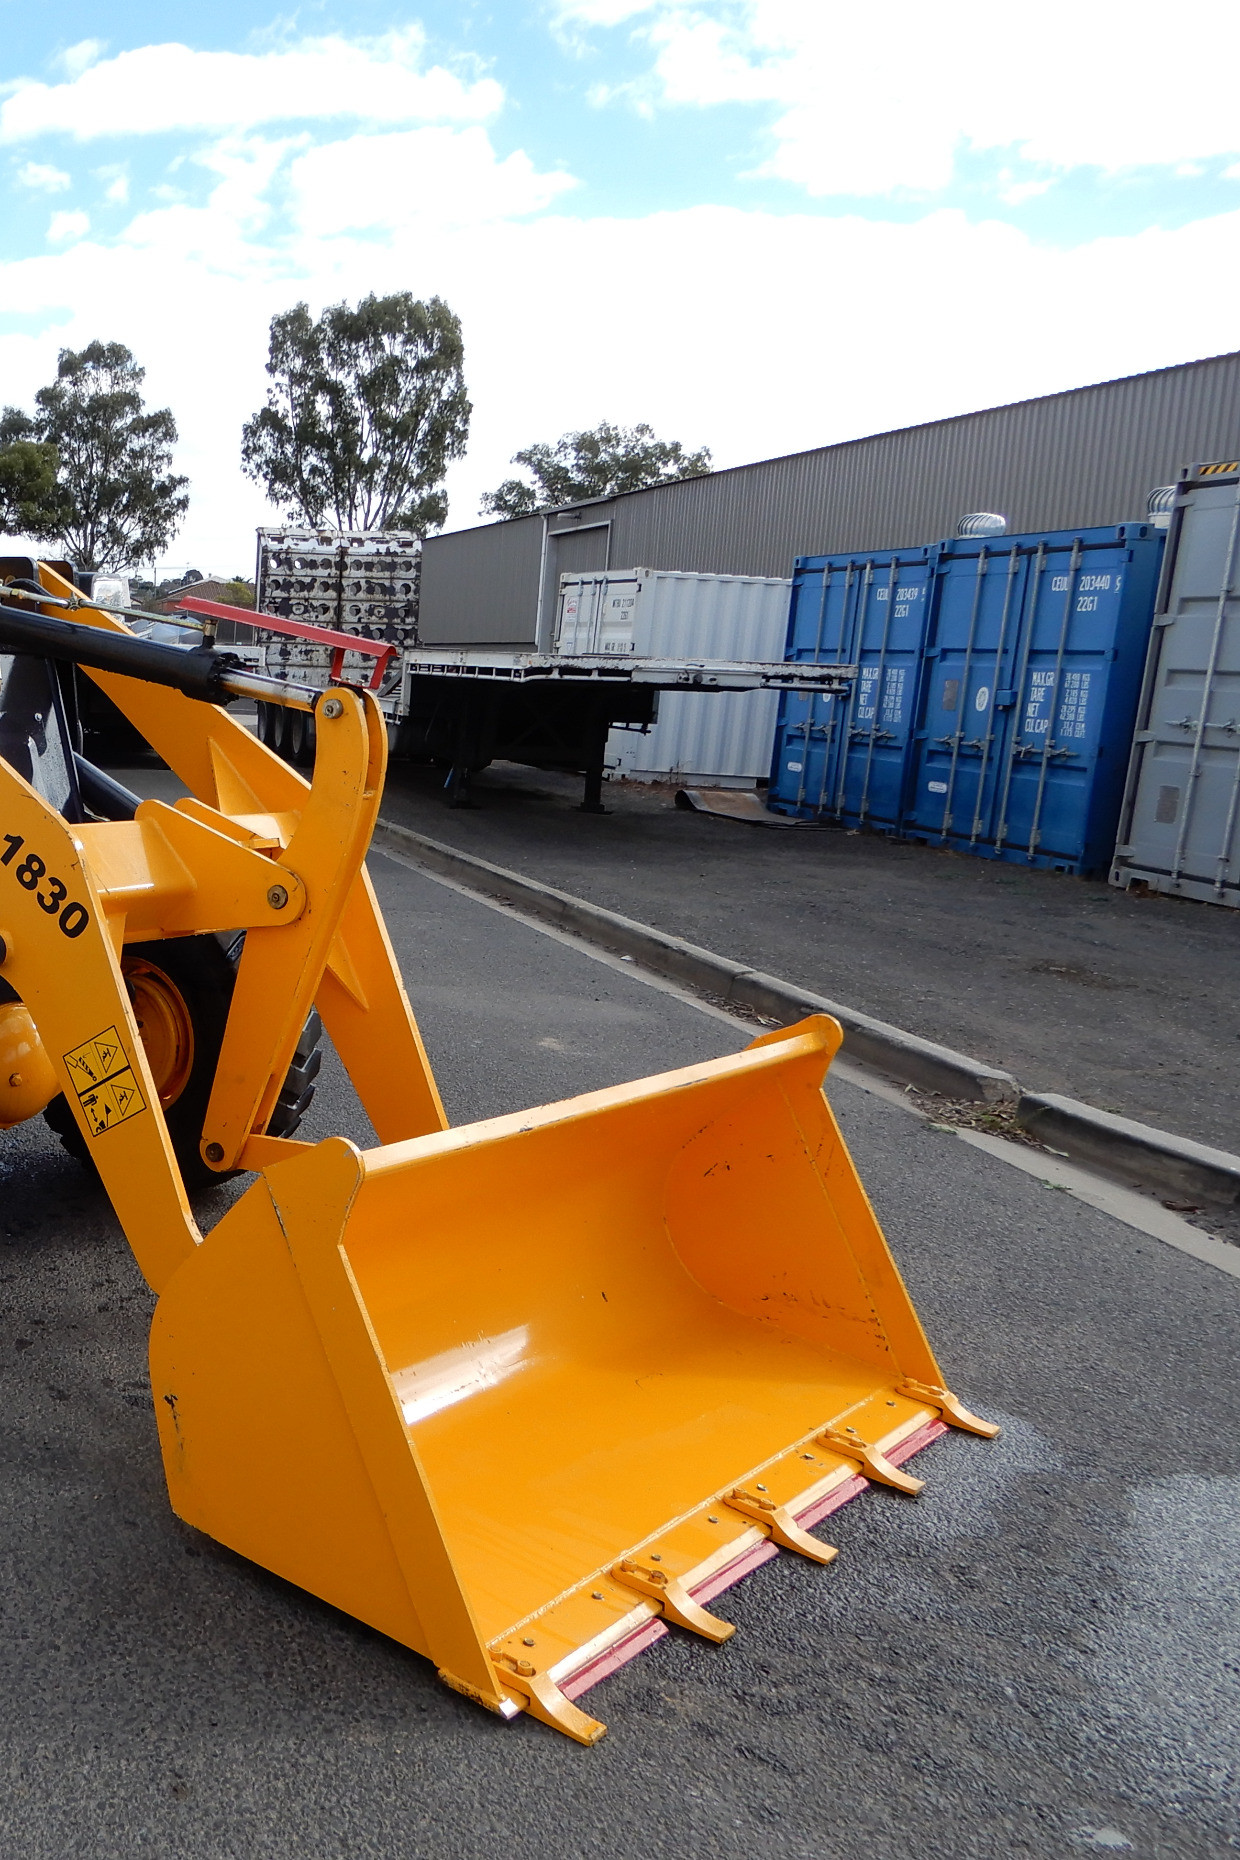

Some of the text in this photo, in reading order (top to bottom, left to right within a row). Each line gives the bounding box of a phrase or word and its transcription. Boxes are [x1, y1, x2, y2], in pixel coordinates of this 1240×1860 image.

[1079, 574, 1111, 591] 203440
[1076, 596, 1098, 612] 22G1
[1026, 702, 1040, 717] NET
[1, 833, 90, 939] 1830
